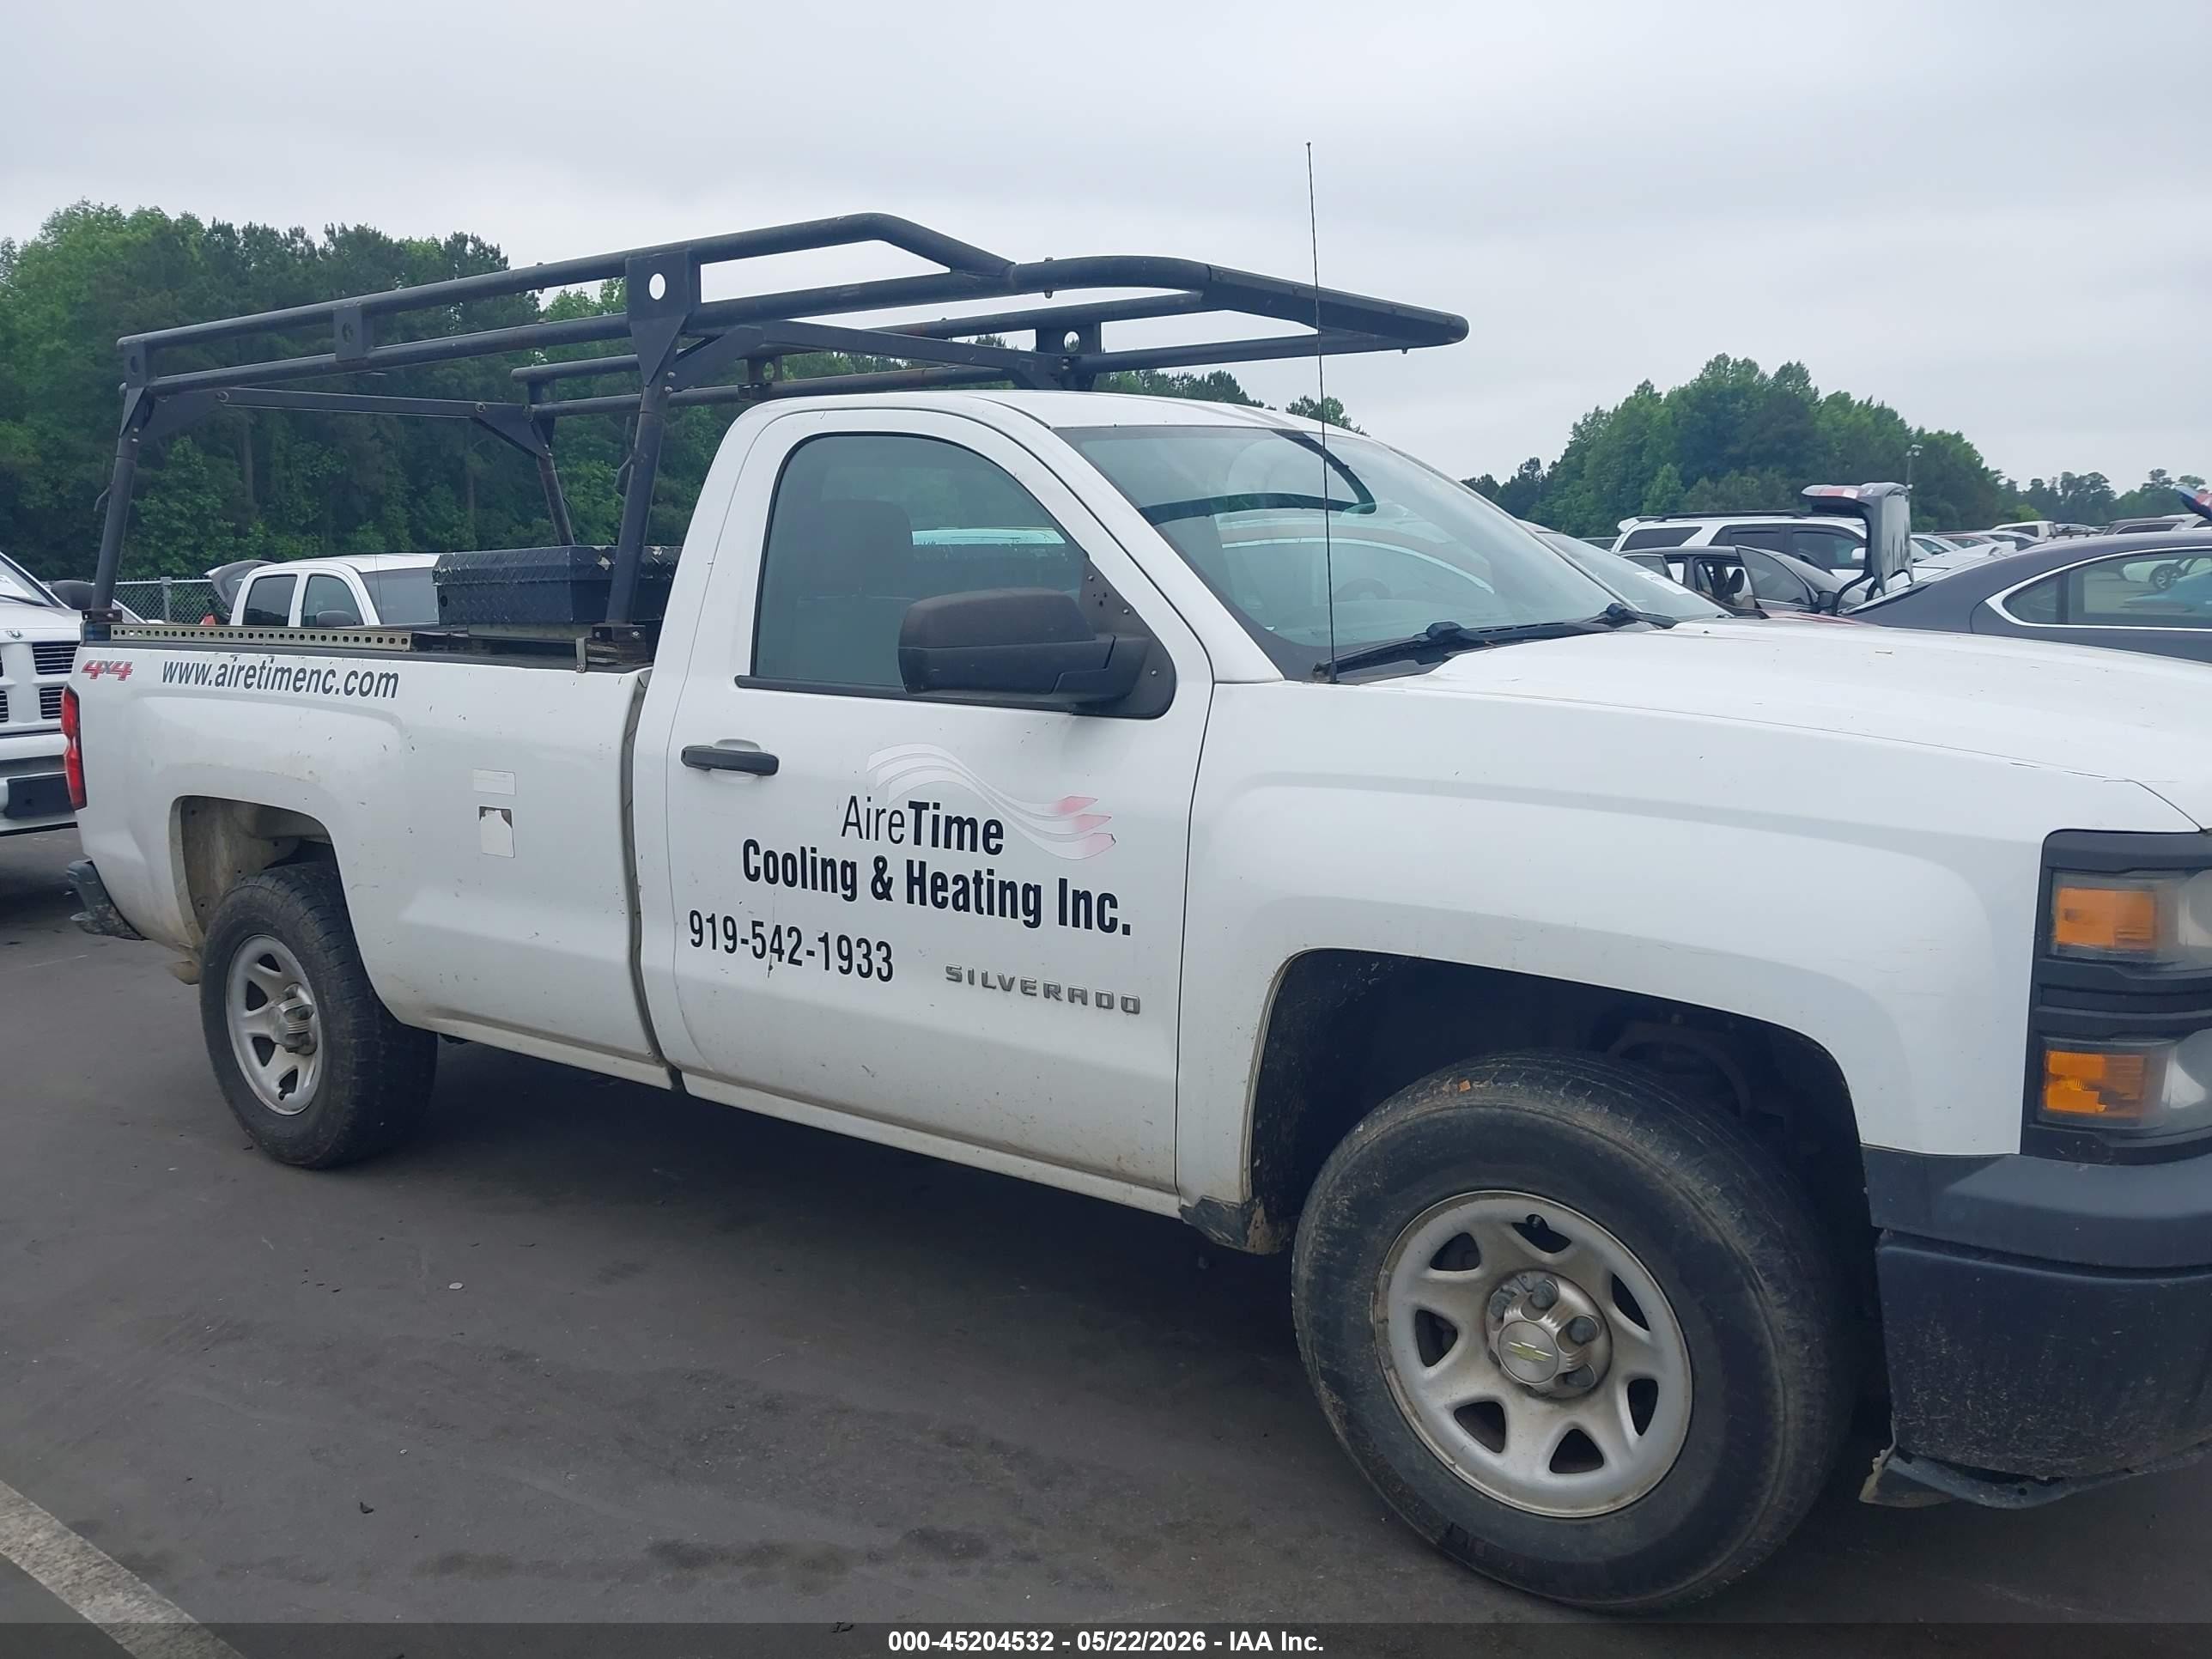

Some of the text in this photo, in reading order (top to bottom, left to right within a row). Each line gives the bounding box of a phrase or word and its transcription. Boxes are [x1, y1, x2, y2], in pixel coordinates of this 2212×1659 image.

[161, 656, 399, 699] www.airetimenc.com
[841, 795, 1004, 856] AireTime
[743, 838, 1131, 936] Cooling & Heating Inc.
[689, 909, 894, 982] 919-542-1933
[945, 965, 1141, 1015] SILVERADO
